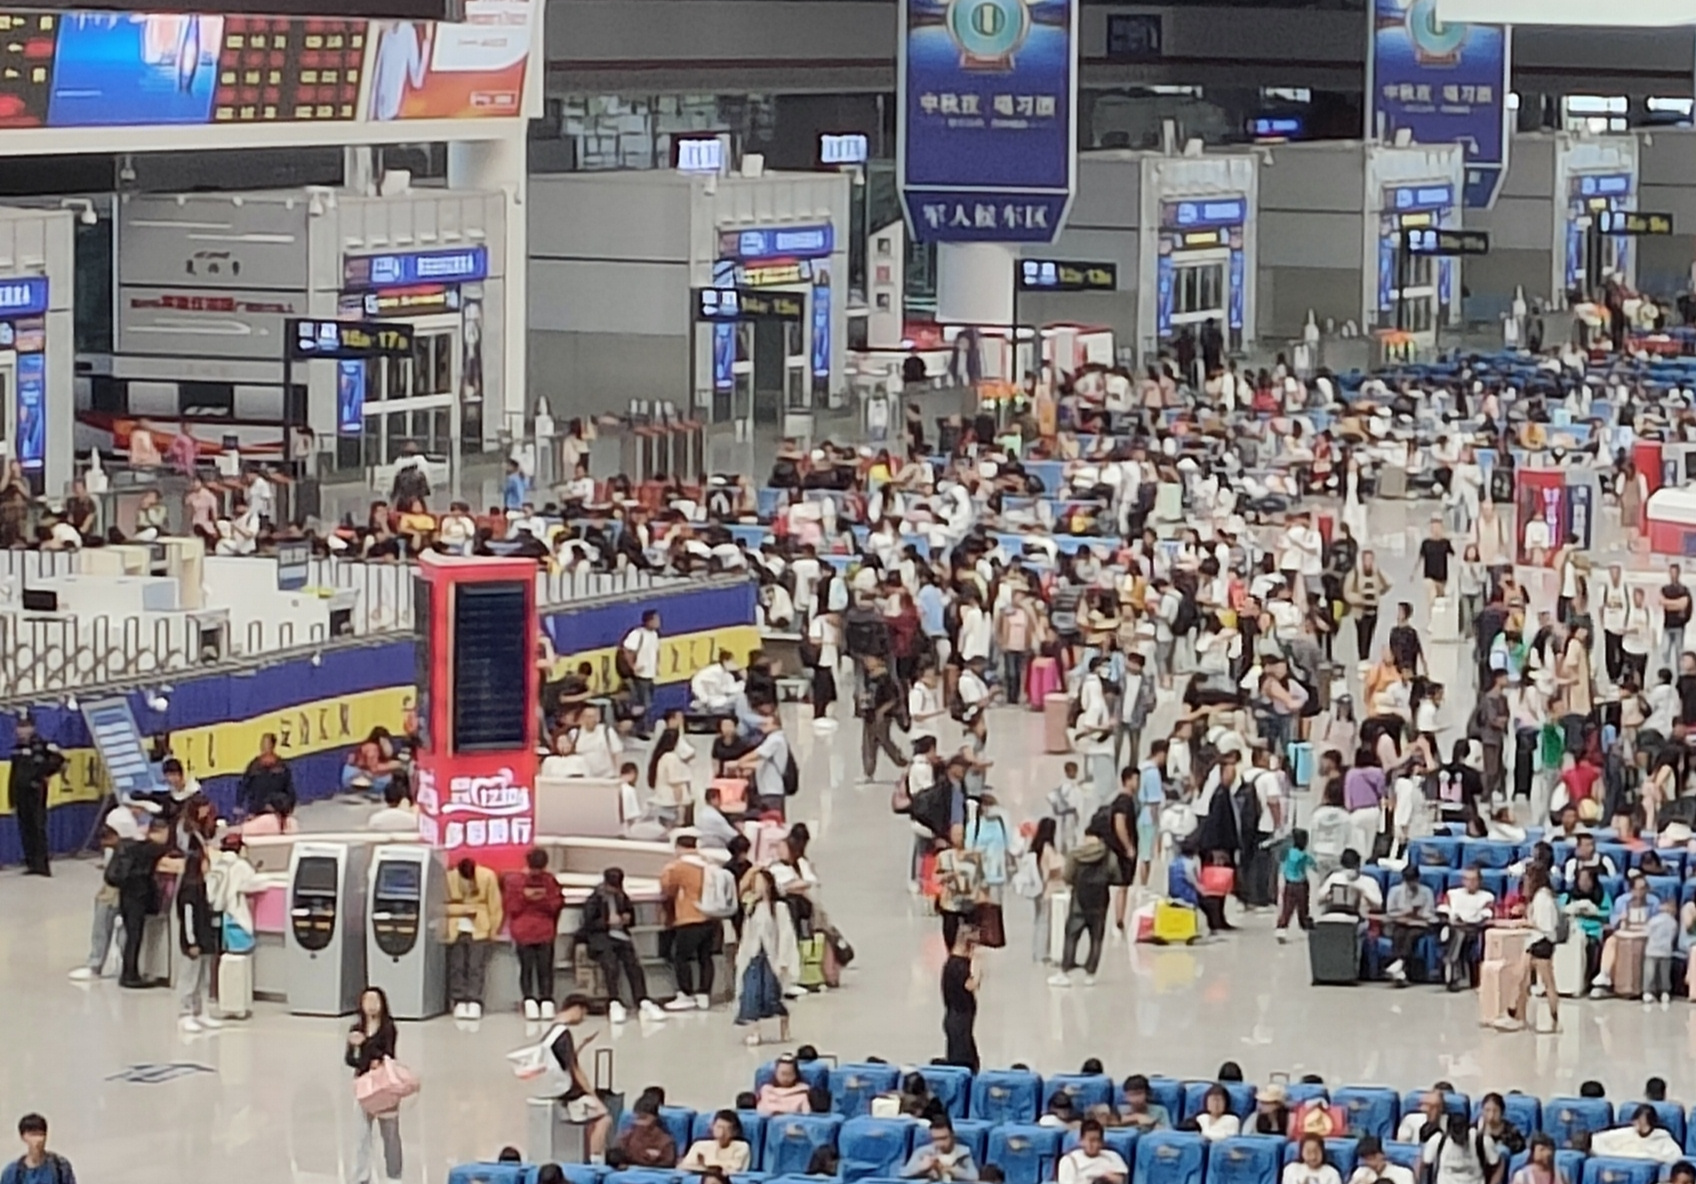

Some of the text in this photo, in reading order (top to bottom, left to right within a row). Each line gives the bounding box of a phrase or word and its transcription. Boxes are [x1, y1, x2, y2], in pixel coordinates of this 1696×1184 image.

[922, 203, 1048, 229] 军人候车区
